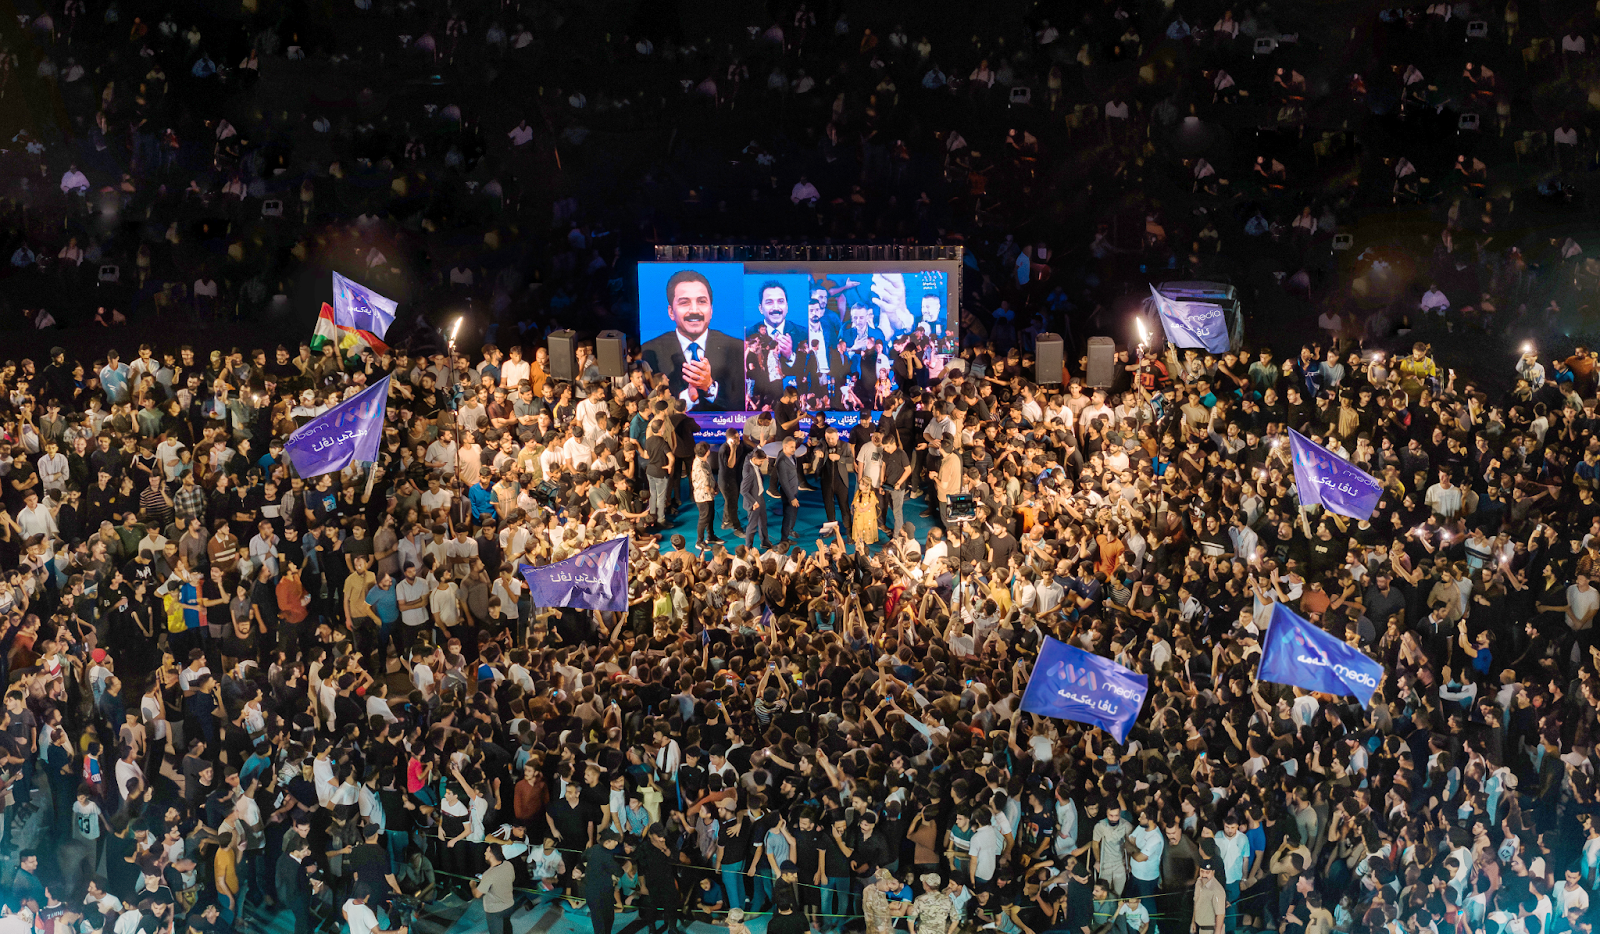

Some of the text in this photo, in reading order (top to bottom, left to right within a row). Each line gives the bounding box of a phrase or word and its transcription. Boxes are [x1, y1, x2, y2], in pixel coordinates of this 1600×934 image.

[1333, 663, 1376, 688] media
[1057, 688, 1119, 715] ئاڤا یەکەمە
[1101, 682, 1141, 703] media
